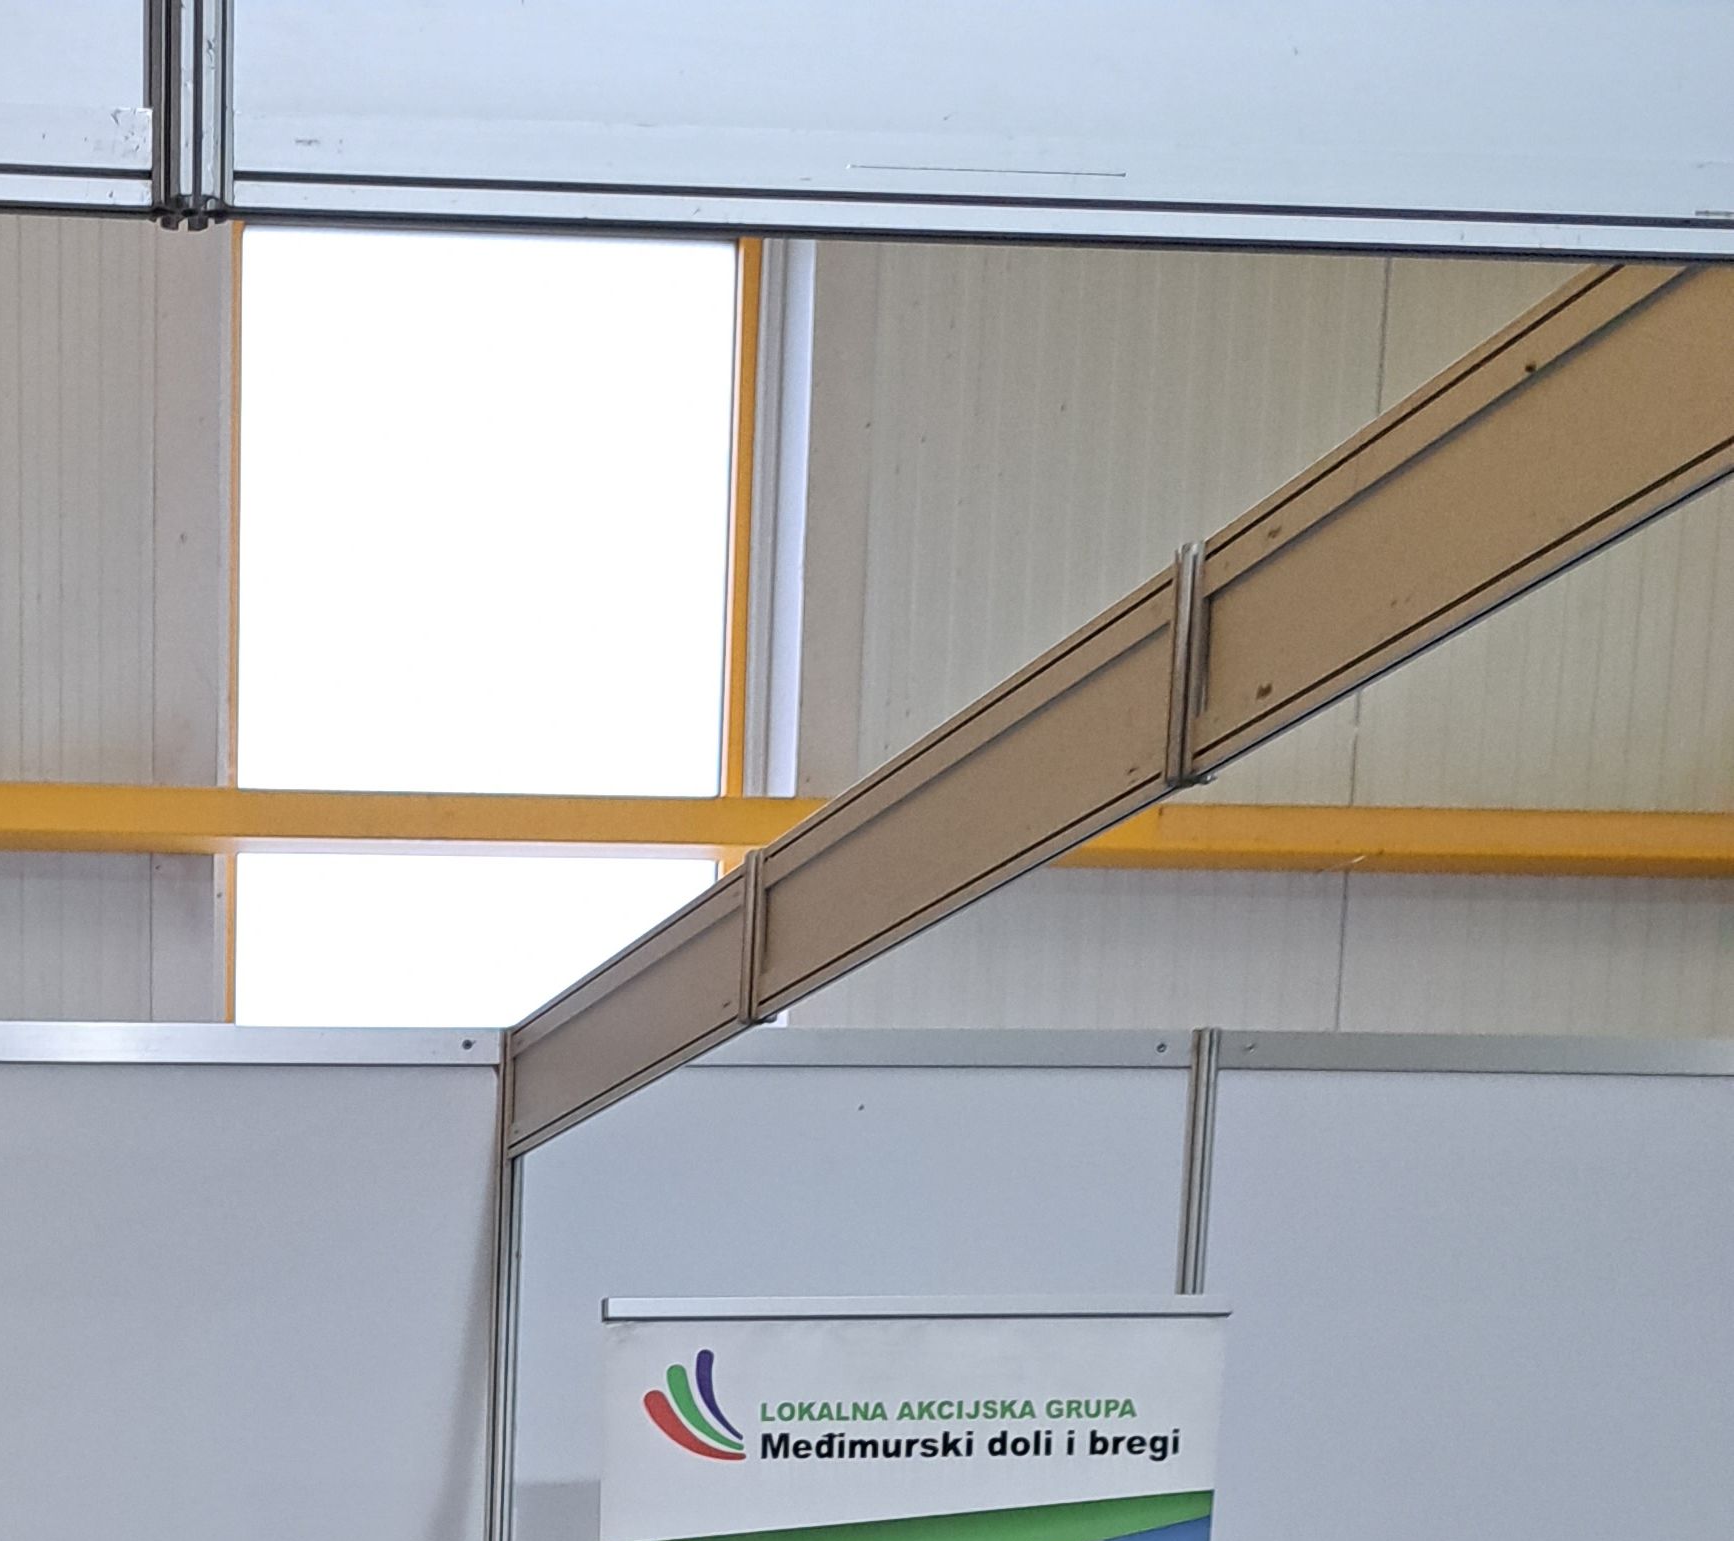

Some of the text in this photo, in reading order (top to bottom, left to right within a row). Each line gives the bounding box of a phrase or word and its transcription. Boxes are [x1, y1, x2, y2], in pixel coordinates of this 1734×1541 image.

[761, 1398, 1138, 1422] LOKALNA AKCIJSKA GRUPA
[760, 1428, 1180, 1462] Međimurski doli i bregi
